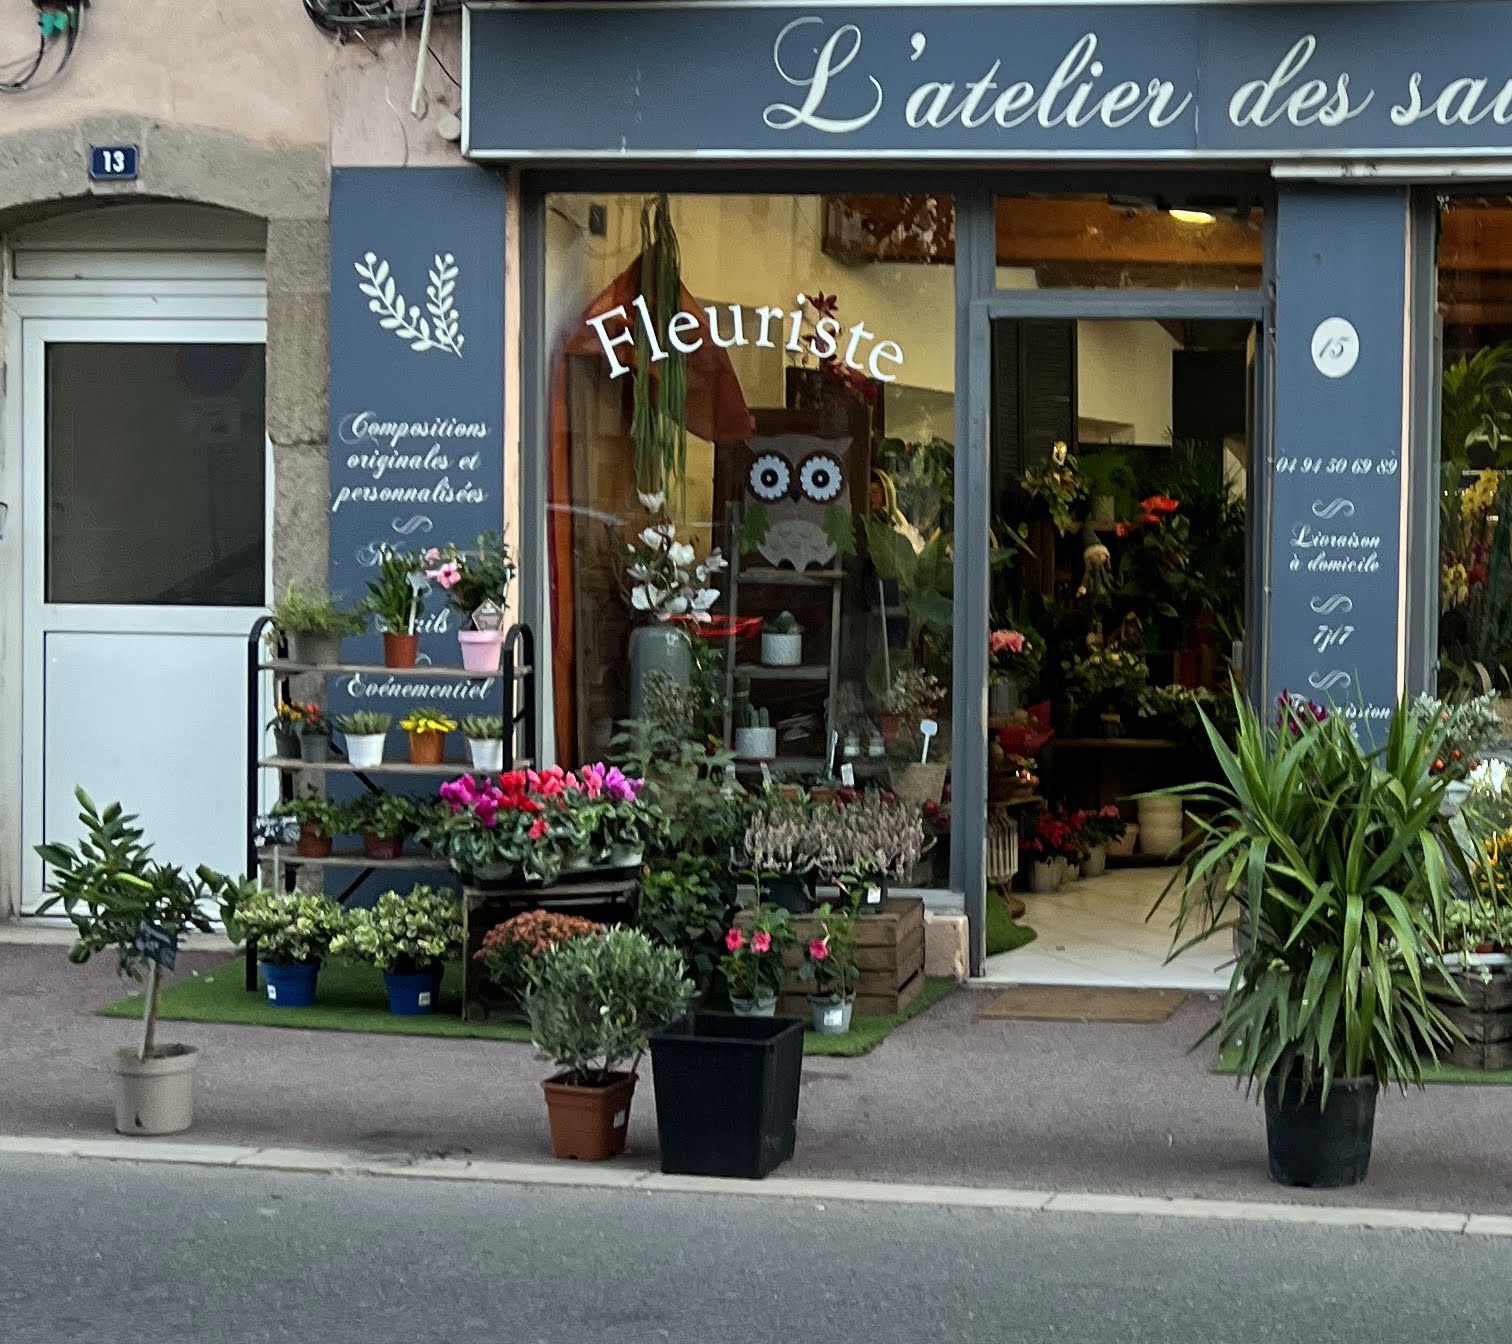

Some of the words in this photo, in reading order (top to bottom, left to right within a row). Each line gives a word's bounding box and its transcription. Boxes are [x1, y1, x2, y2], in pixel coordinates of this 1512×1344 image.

[762, 16, 1193, 133] L'atelier
[1228, 34, 1375, 128] des
[102, 149, 125, 173] 13
[585, 291, 905, 384] Fleuriste
[1318, 336, 1350, 359] 15
[338, 410, 492, 448] Compositions
[346, 442, 452, 480] originales
[458, 451, 481, 471] et
[331, 475, 489, 513] personnalisées
[1290, 523, 1381, 549] Livraison
[1307, 551, 1380, 573] domicile
[1313, 624, 1355, 654] 7j/7
